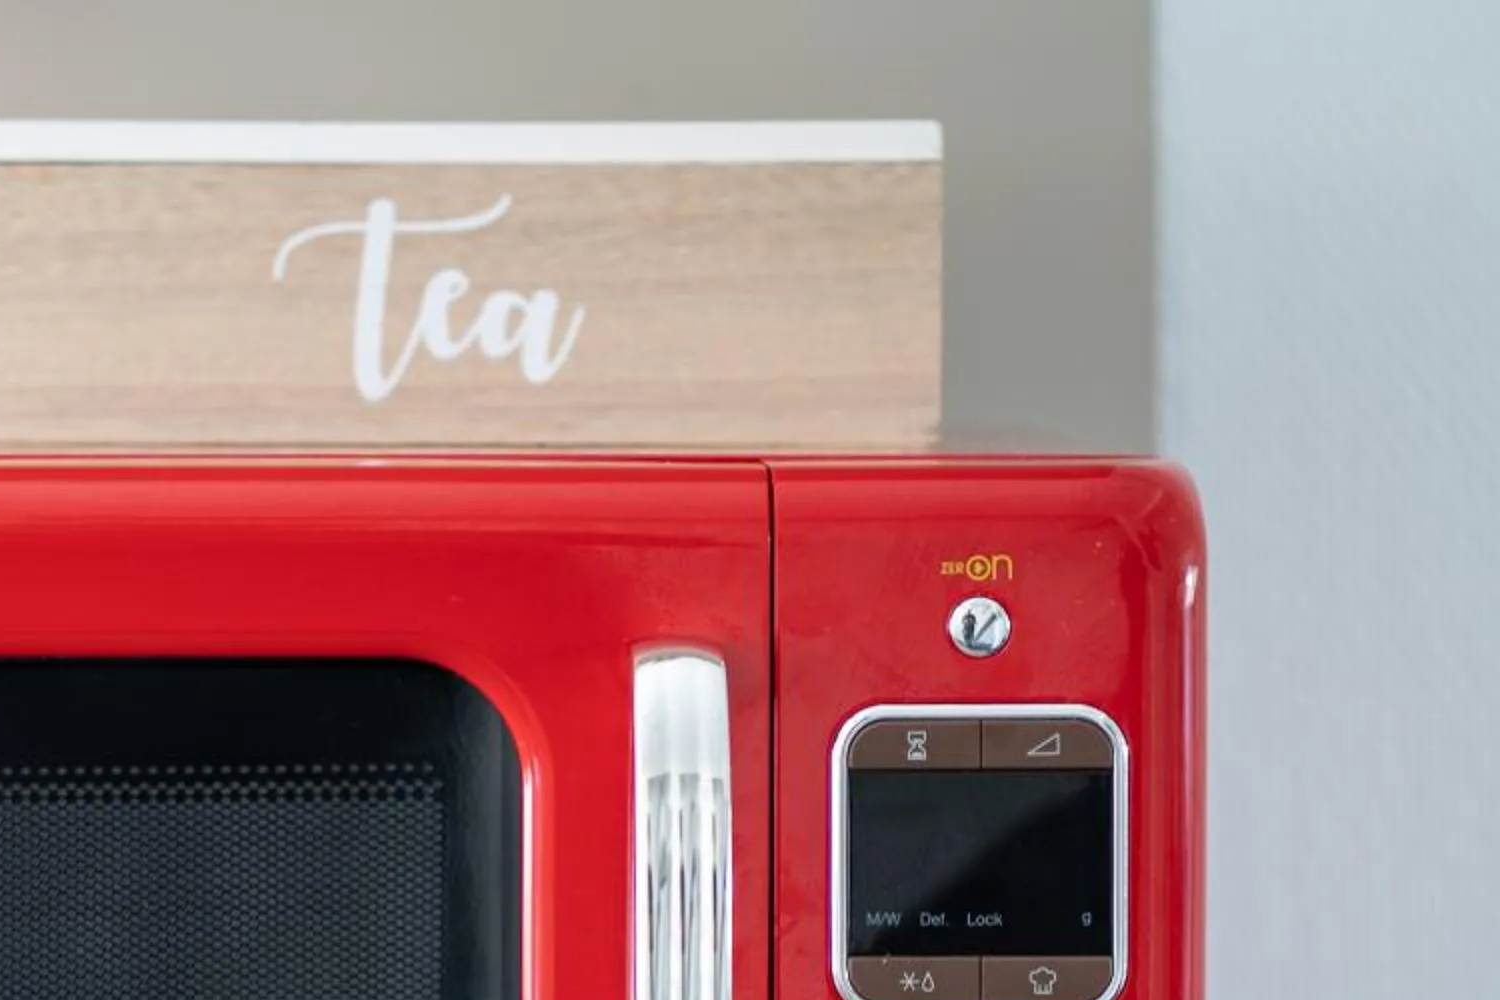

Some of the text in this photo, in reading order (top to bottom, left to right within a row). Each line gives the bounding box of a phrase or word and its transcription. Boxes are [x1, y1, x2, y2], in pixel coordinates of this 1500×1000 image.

[272, 192, 585, 402] tea
[866, 911, 901, 927] M/W
[967, 911, 1003, 927] Lock
